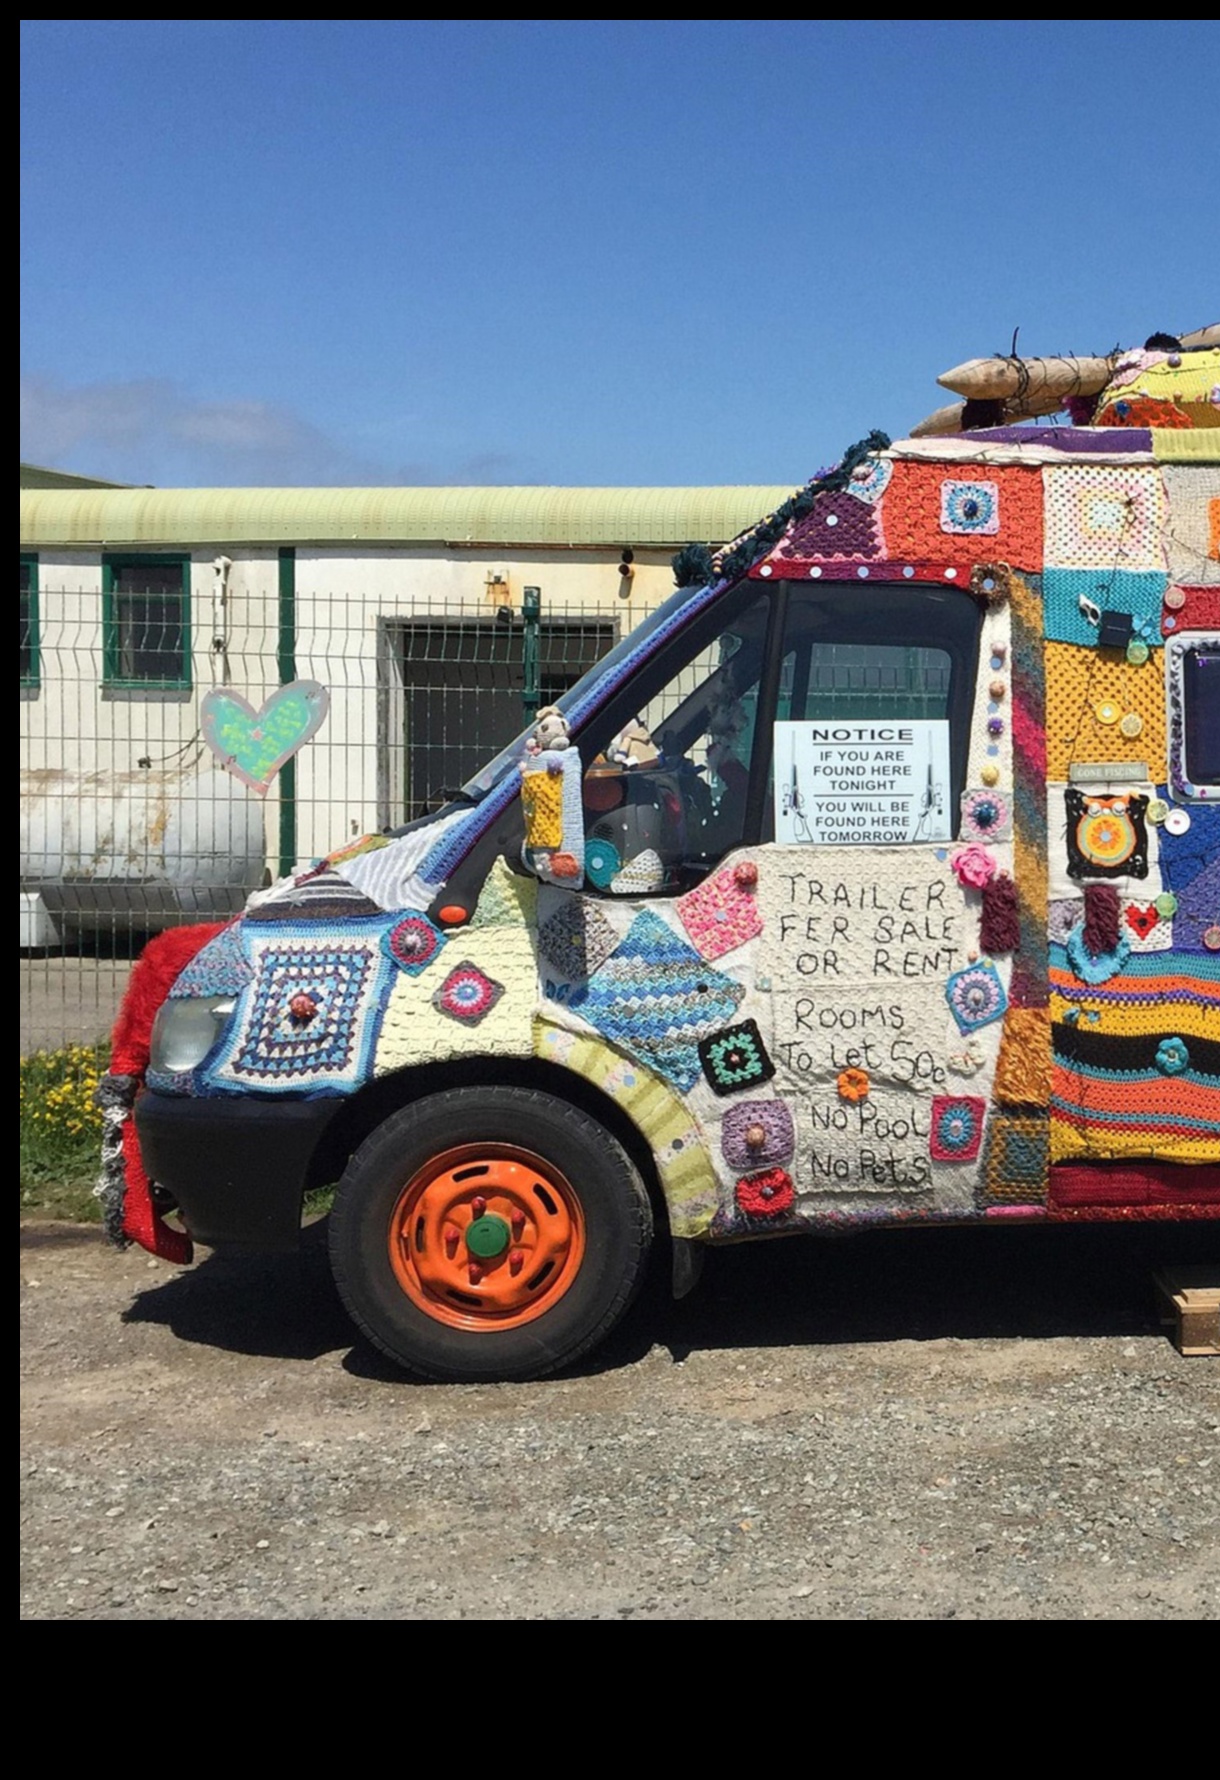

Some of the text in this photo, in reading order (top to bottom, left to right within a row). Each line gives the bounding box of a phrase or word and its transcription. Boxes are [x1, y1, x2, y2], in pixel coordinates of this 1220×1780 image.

[812, 729, 914, 741] NOTICE
[820, 751, 905, 762] IF YOU ARE
[813, 765, 912, 776] FOUND HERE
[829, 780, 897, 791] TONIGHT
[815, 801, 910, 813] YOU WILL BE
[815, 816, 911, 827] FOUND HERE
[818, 831, 908, 842] TOMORROW
[778, 872, 946, 912] TRAILER
[780, 913, 956, 944] FER SALE
[796, 948, 959, 977] OR RENT
[830, 1038, 883, 1069] Let
